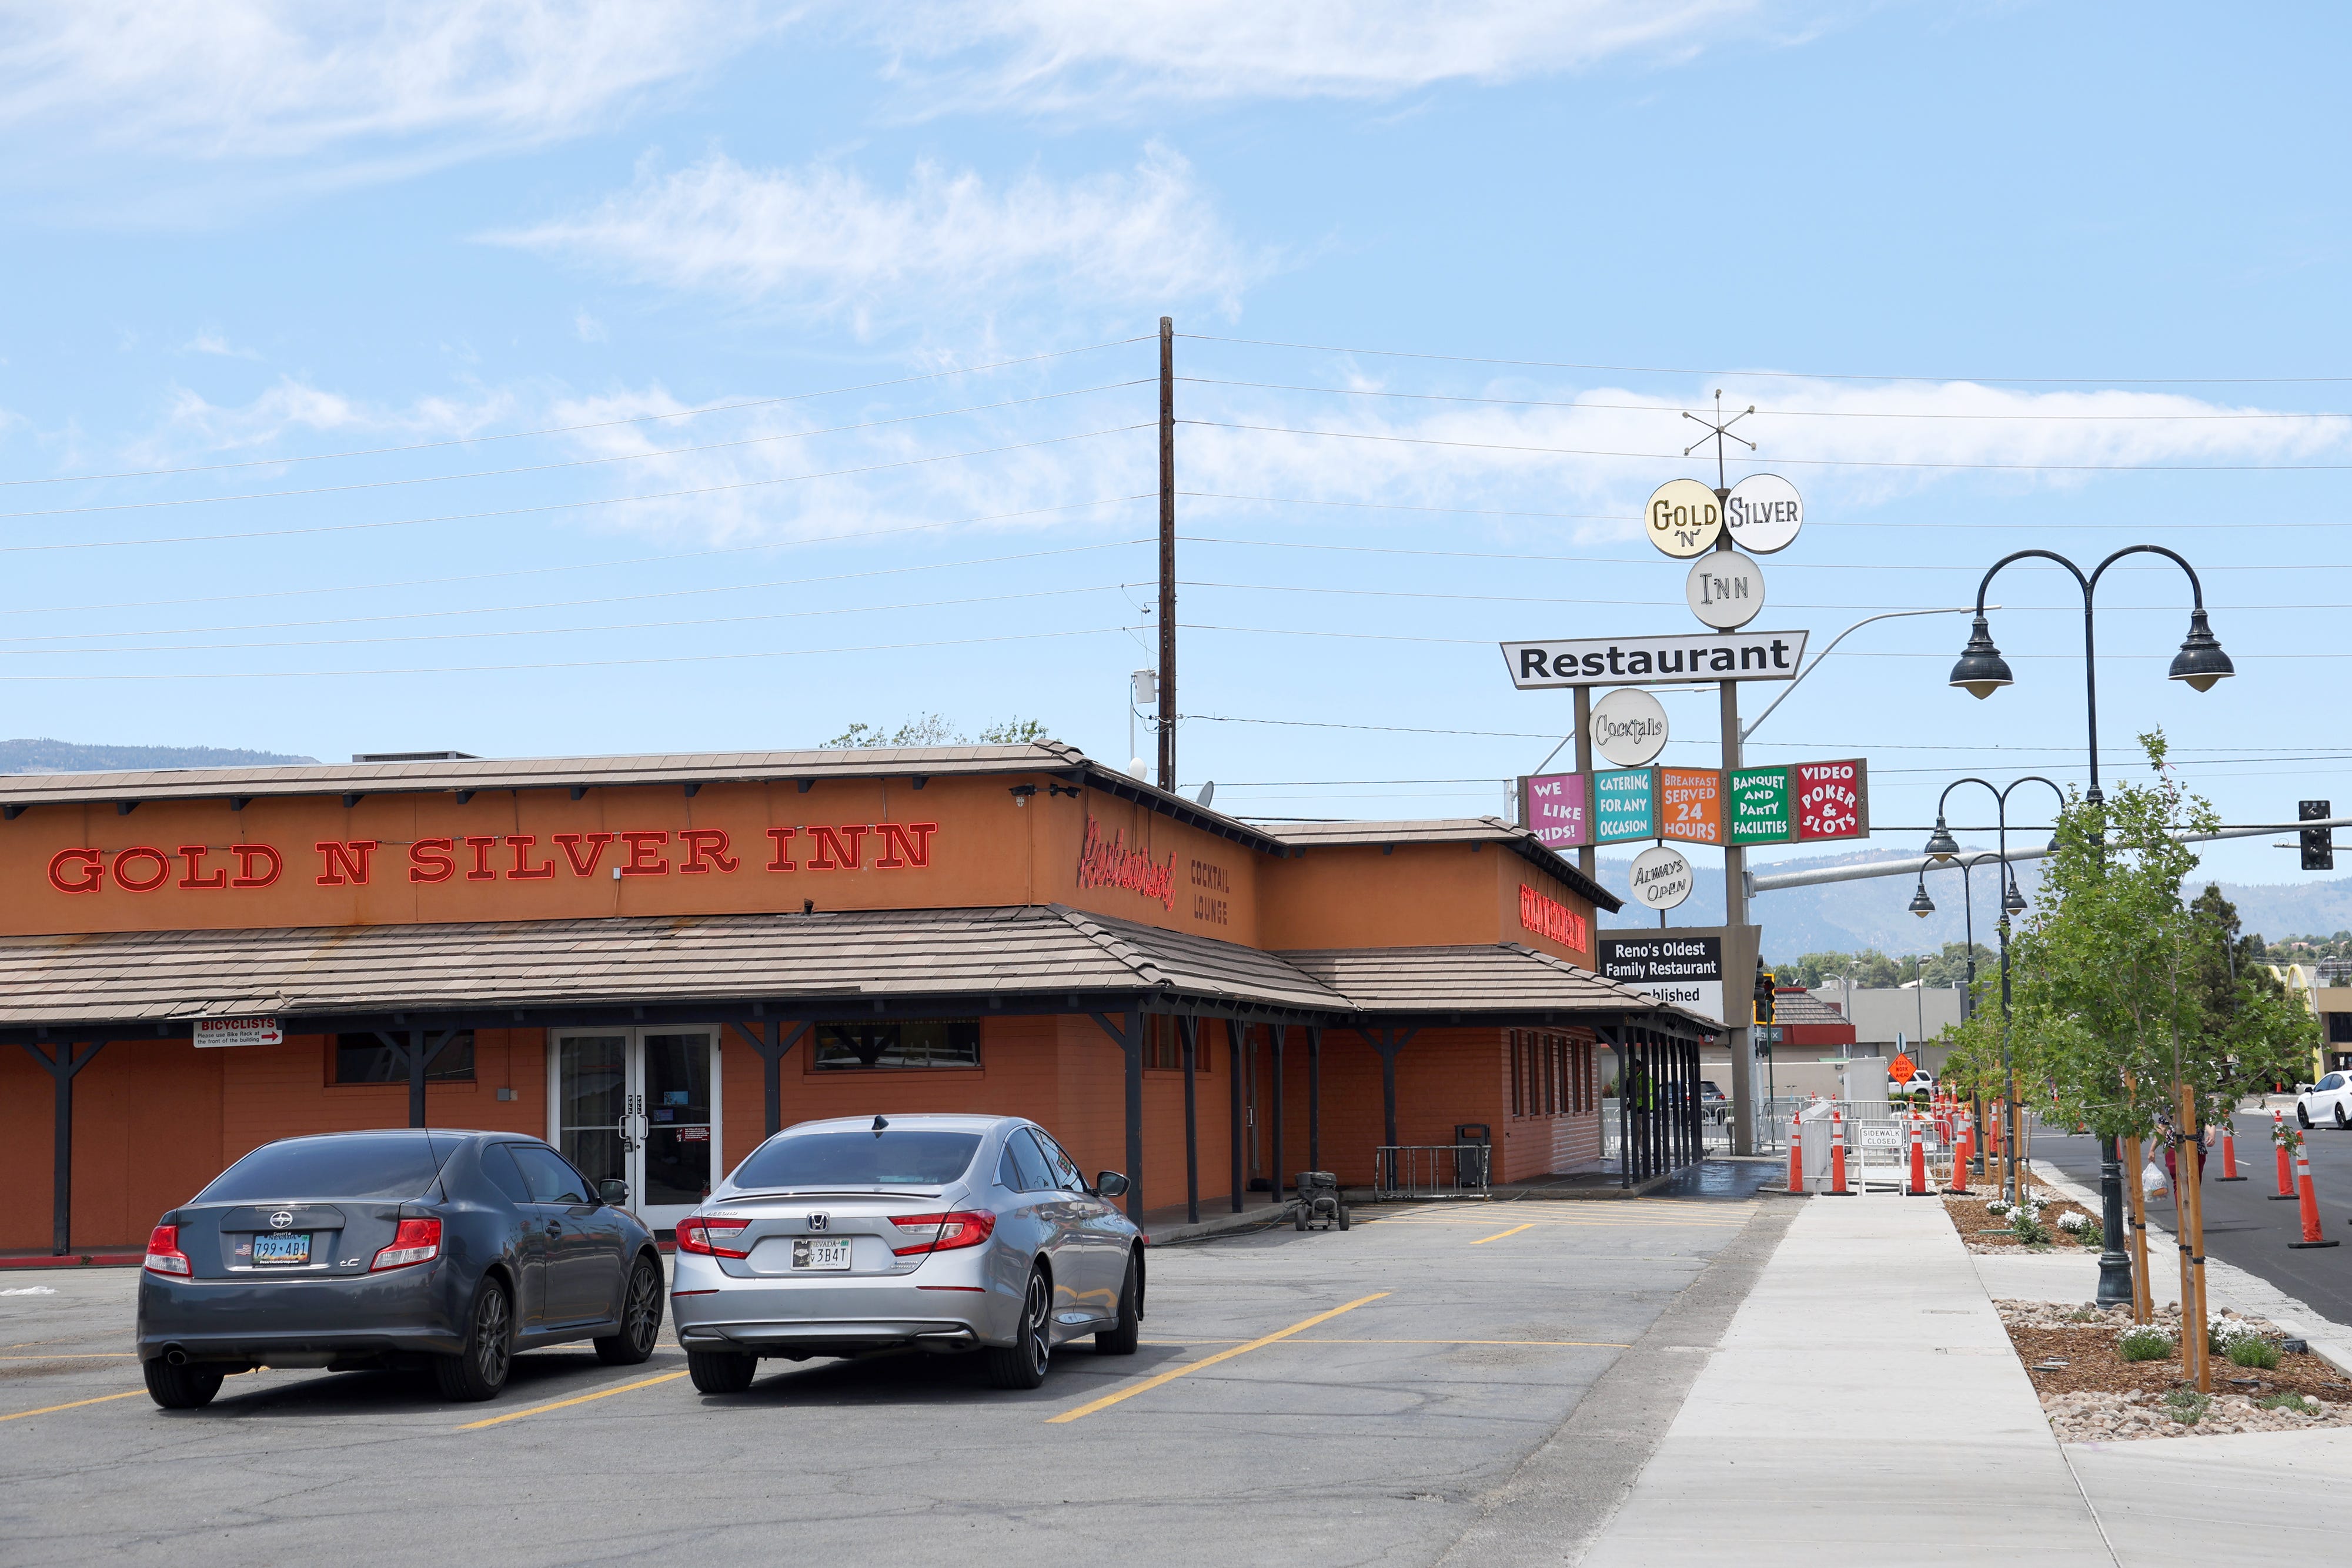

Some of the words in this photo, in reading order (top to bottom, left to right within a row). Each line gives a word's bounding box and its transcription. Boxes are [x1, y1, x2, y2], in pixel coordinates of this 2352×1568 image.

[1652, 500, 1717, 530] GOLD
[1729, 497, 1798, 529] SILVER
[1699, 573, 1748, 605] INN
[1520, 639, 1790, 679] Restaurant
[1595, 714, 1663, 746] Cocktails
[1665, 774, 1717, 787] BREAKFAST
[1801, 765, 1853, 780] VIDEO
[1534, 781, 1562, 798] WE
[1599, 774, 1649, 791] CATERING
[1733, 775, 1785, 791] BANQUET
[1665, 788, 1716, 805] SERVED
[1744, 790, 1774, 800] AND
[1801, 784, 1856, 810] POKER
[1542, 803, 1582, 821] LIKE
[1600, 798, 1622, 813] FOR
[1623, 798, 1647, 811] ANY
[1676, 803, 1703, 821] 24
[1822, 803, 1836, 817] &
[1600, 820, 1648, 837] OCCASION
[1665, 823, 1716, 841] HOURS
[1734, 820, 1787, 834] FACILITIES
[1802, 813, 1856, 833] SLOTS
[1533, 825, 1575, 841] KIDS!
[48, 844, 282, 894] GOLD
[315, 840, 377, 886] N
[409, 829, 740, 883] SILVER
[766, 823, 938, 873] INN
[1080, 813, 1176, 912] Restaurant
[1191, 859, 1230, 894] COCKTAIL
[1633, 859, 1683, 887] ALWAYS
[1647, 878, 1686, 901] OPEN
[1194, 894, 1228, 925] LOUNGE
[1521, 884, 1543, 934] GOLD
[1550, 900, 1575, 949] SILVER
[1616, 942, 1660, 958] Reno's
[1662, 942, 1706, 957] Oldest
[1606, 962, 1646, 979] Family
[1649, 960, 1717, 975] Restaurant
[202, 1018, 275, 1031] BICYCLISTS
[339, 1258, 360, 1266] tC
